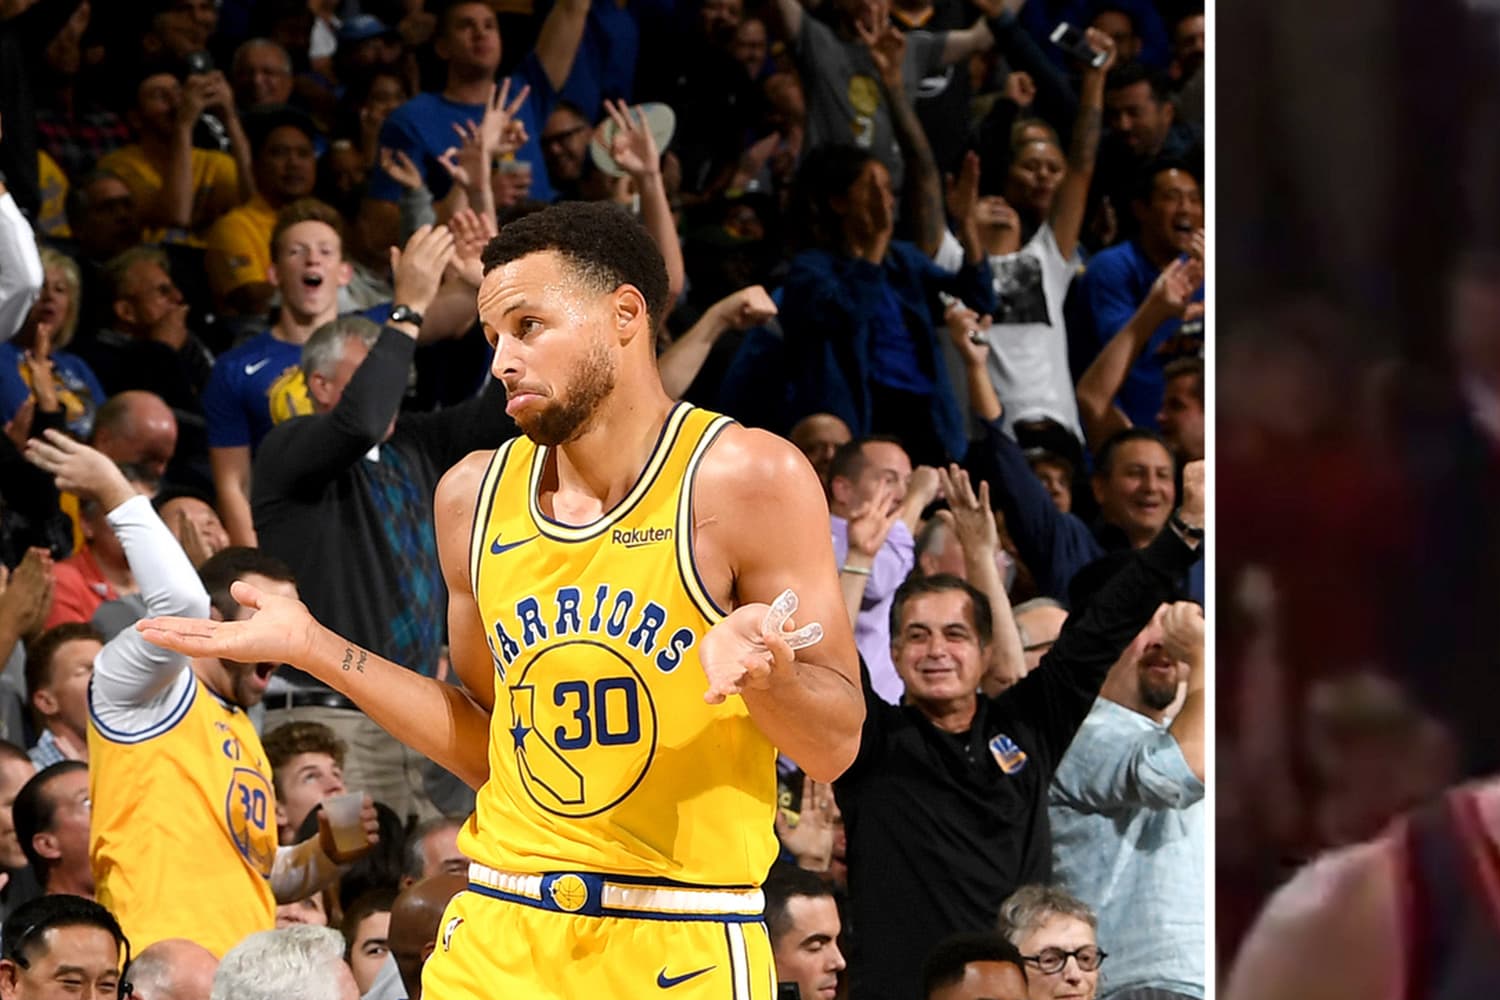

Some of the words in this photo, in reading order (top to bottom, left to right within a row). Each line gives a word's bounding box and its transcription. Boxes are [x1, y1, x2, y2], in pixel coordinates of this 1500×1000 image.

[611, 527, 673, 547] Rakuten
[553, 676, 641, 750] 30
[238, 783, 267, 831] 30
